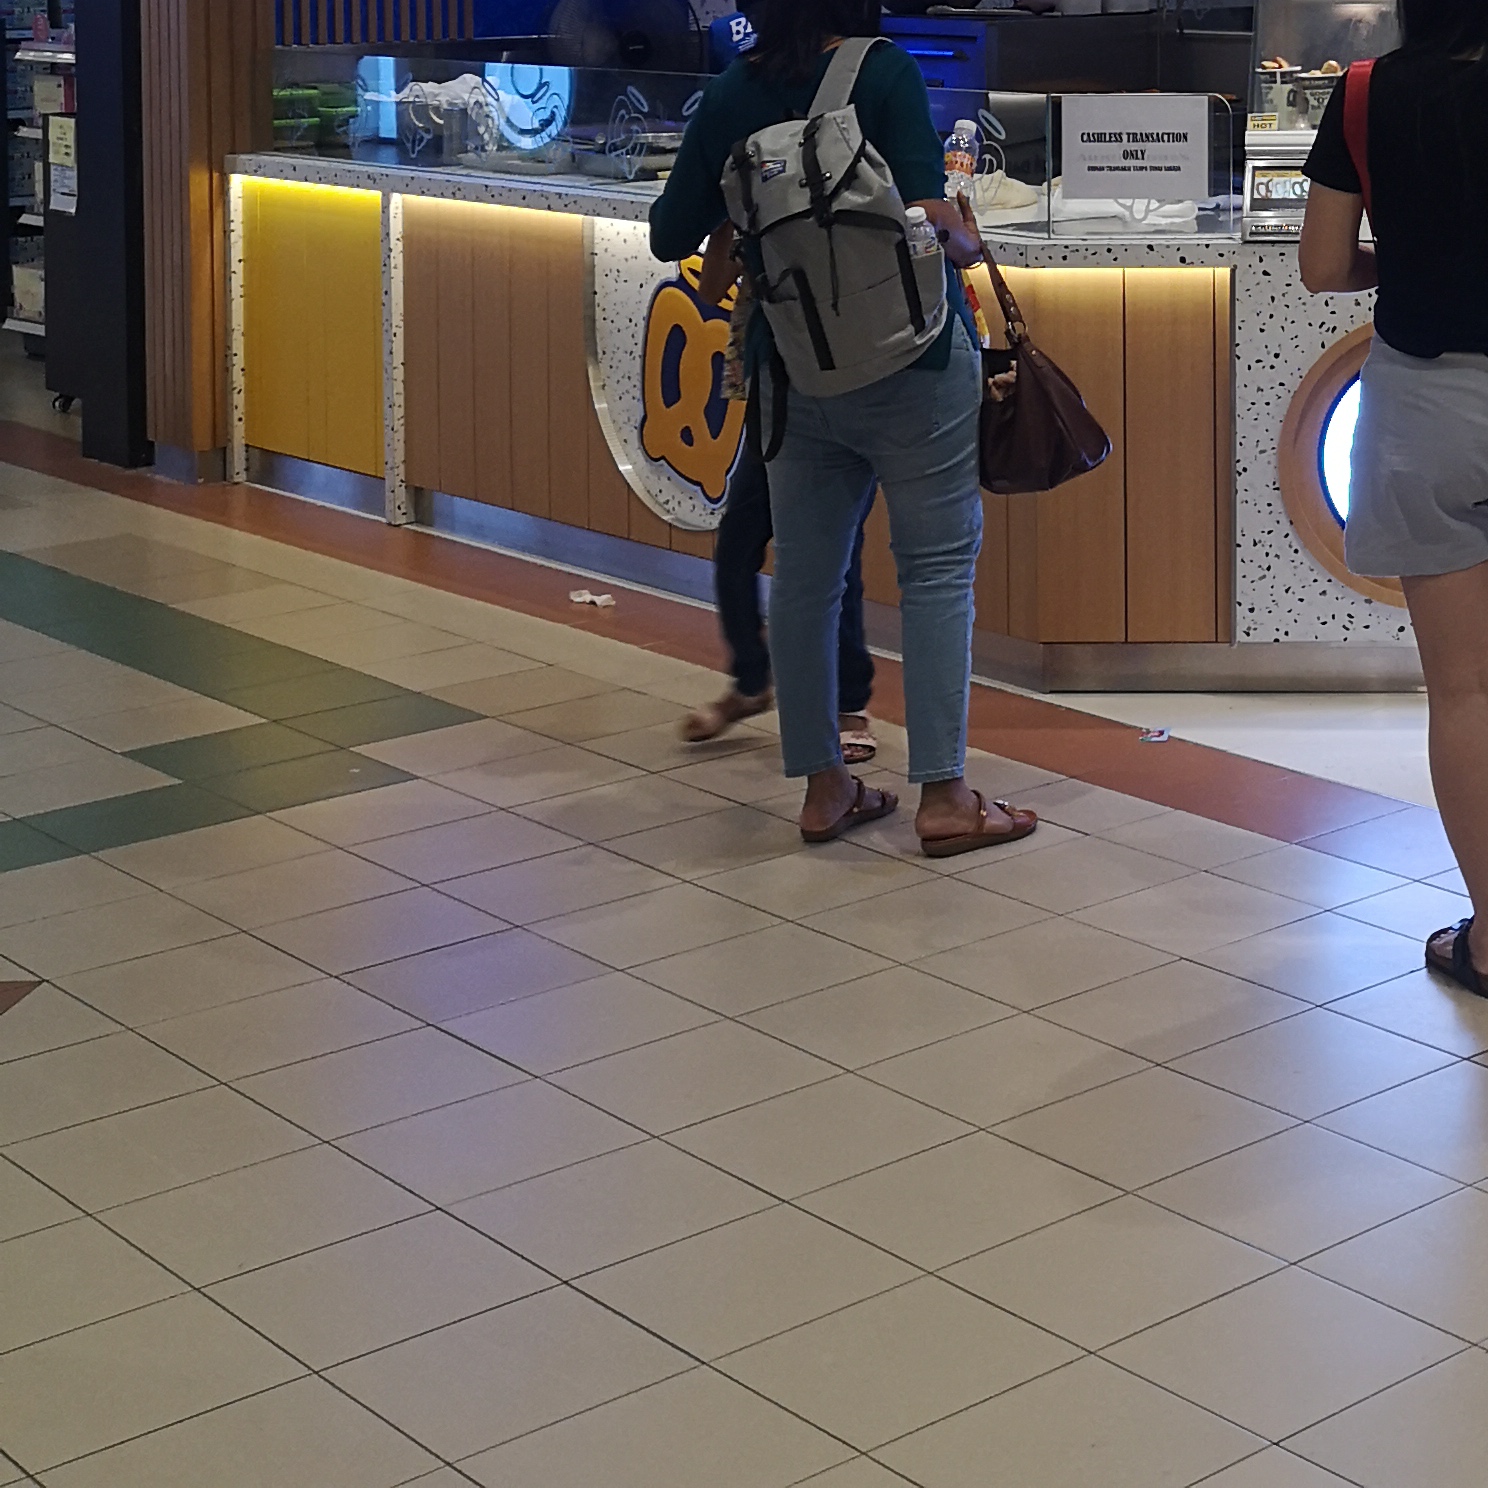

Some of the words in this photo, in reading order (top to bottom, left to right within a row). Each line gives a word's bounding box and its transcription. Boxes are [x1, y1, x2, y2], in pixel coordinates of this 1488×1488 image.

[1080, 131, 1123, 144] CASHLESS
[1125, 131, 1189, 144] TRANSACTION
[1122, 148, 1147, 161] ONLY
